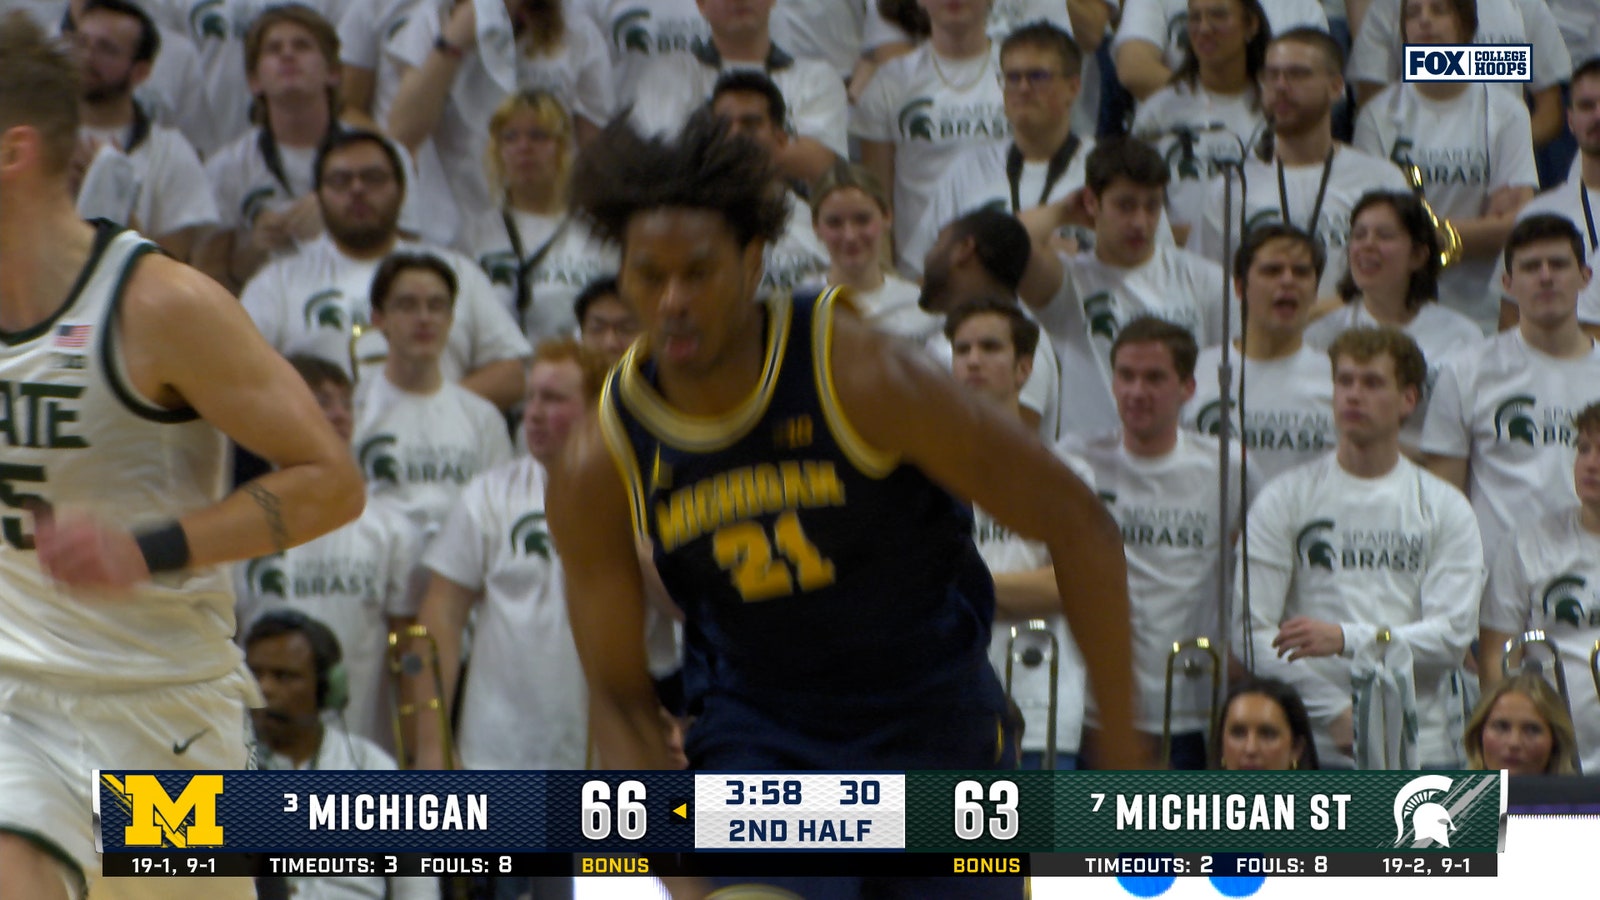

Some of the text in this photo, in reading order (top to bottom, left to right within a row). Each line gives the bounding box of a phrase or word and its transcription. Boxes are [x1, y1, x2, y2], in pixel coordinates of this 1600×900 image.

[656, 461, 846, 552] MICHIGAN
[1120, 525, 1204, 549] BRASS
[1341, 528, 1424, 550] SPARTAN
[713, 509, 835, 601] 21
[1341, 547, 1420, 571] BRASS
